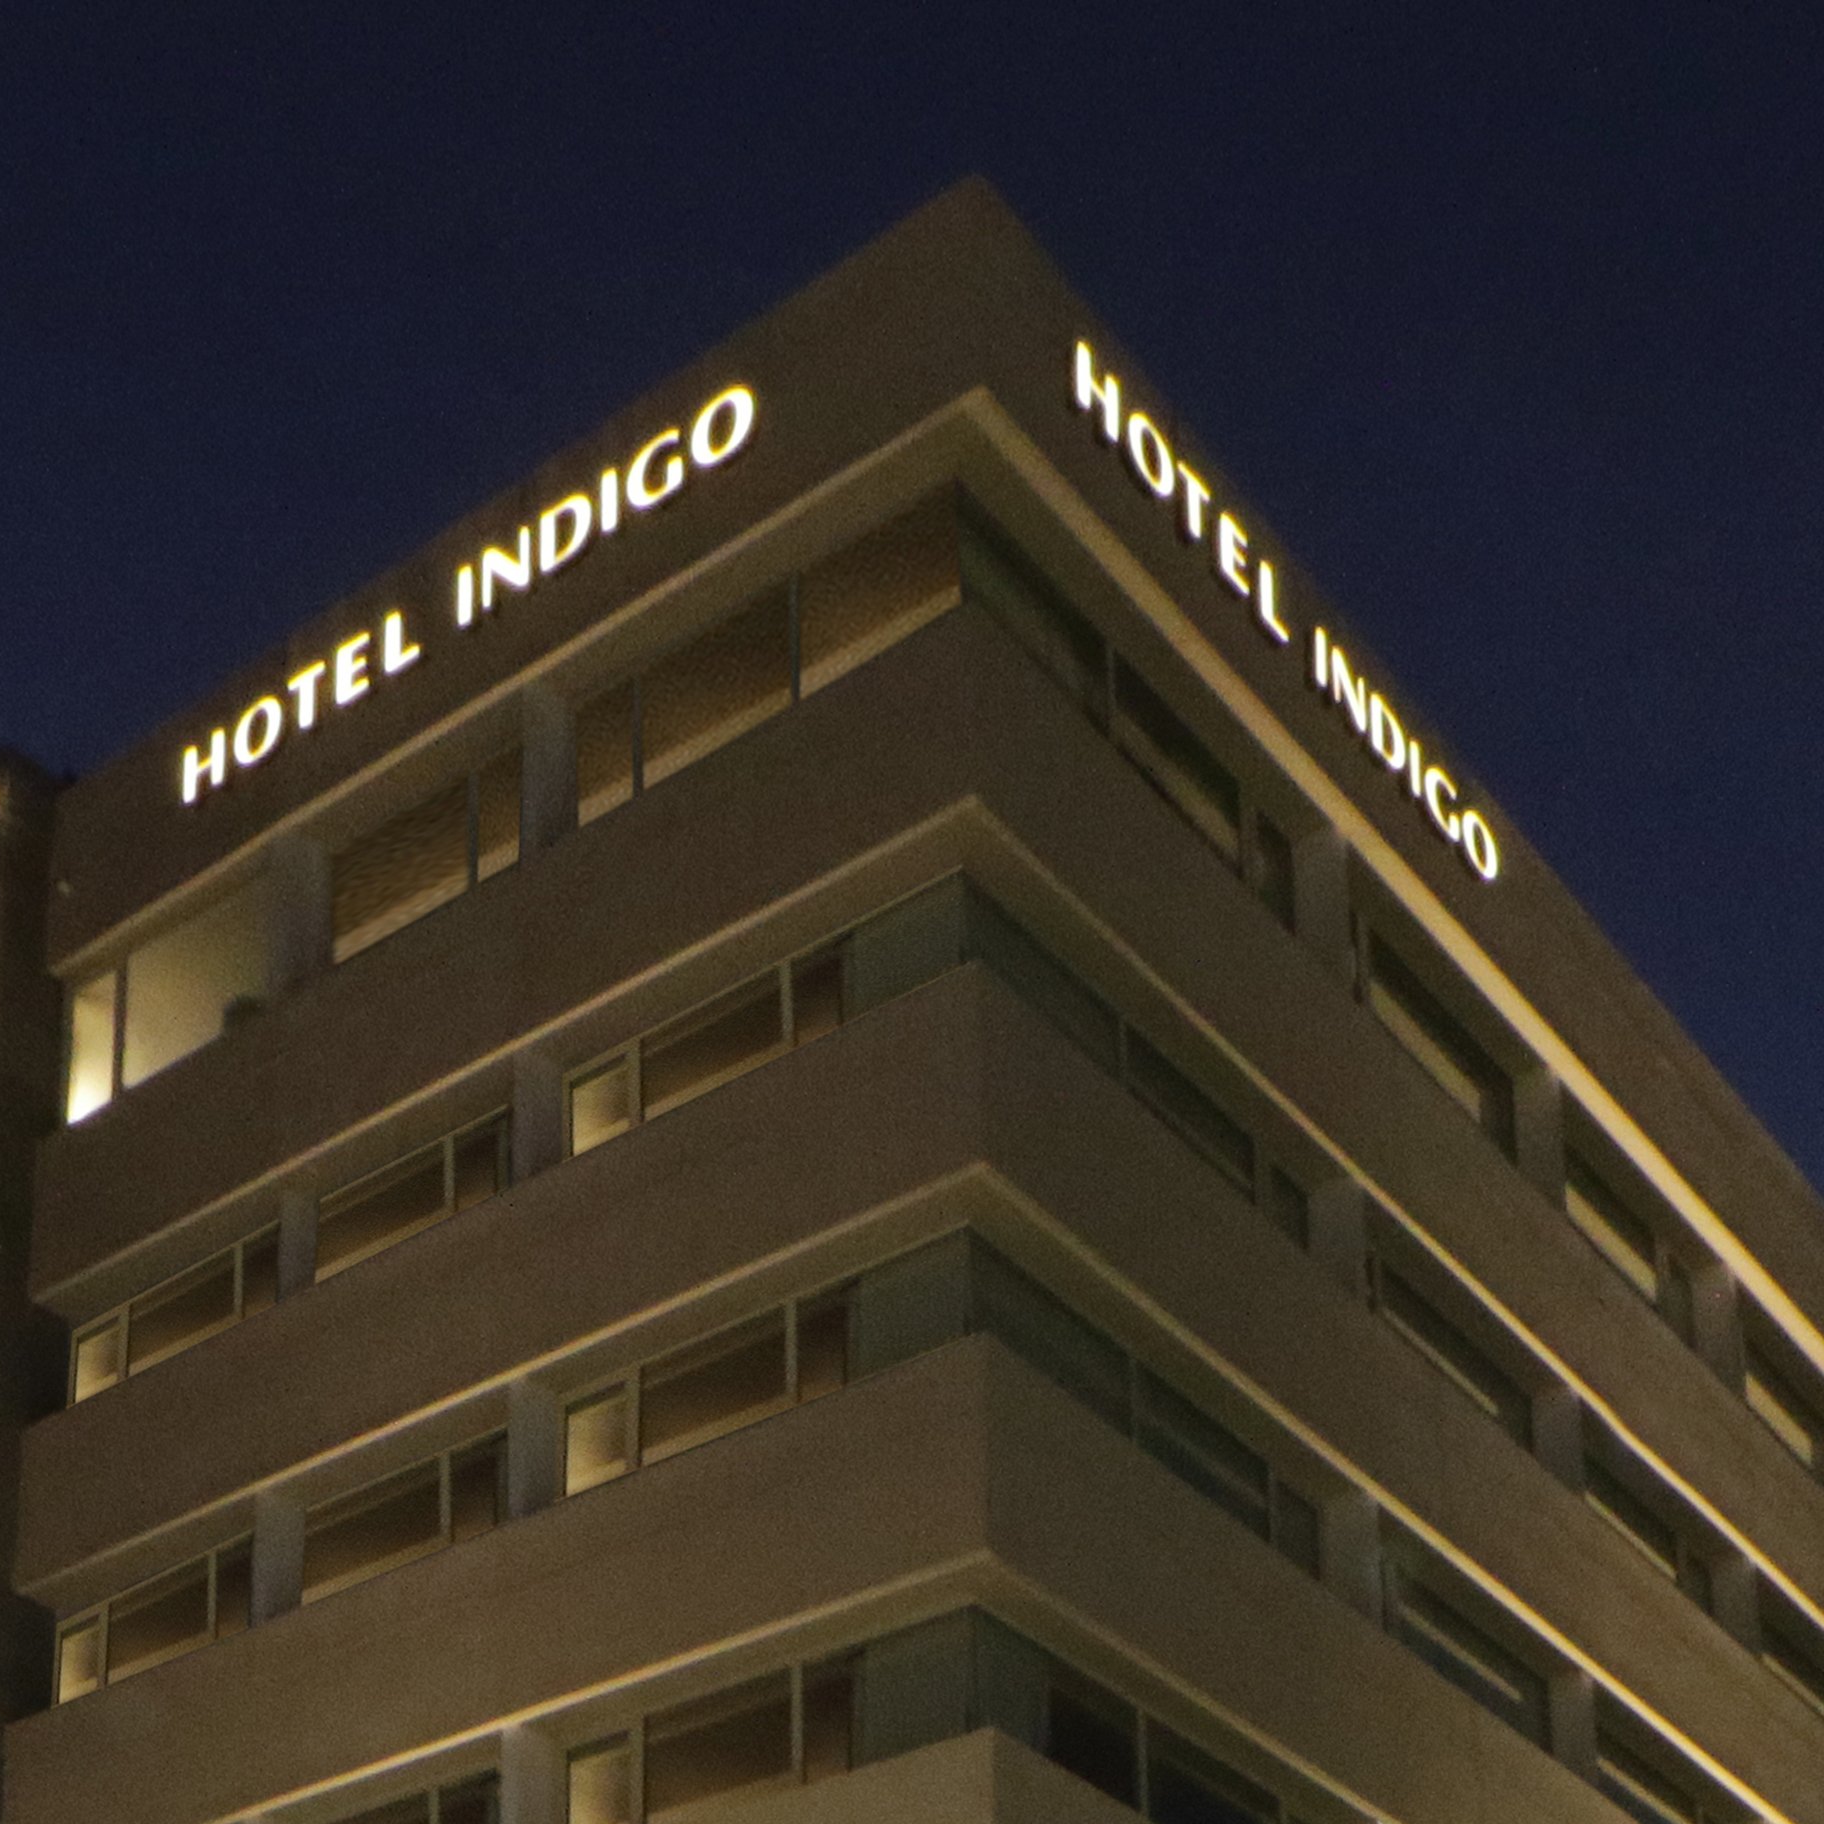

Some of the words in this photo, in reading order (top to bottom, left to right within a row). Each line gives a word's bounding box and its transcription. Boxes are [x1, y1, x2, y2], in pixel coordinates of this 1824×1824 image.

[181, 610, 421, 804] HOTEL
[456, 385, 755, 627] INDIGO
[1075, 341, 1289, 643] HOTEL
[1314, 626, 1499, 881] INDIGO
